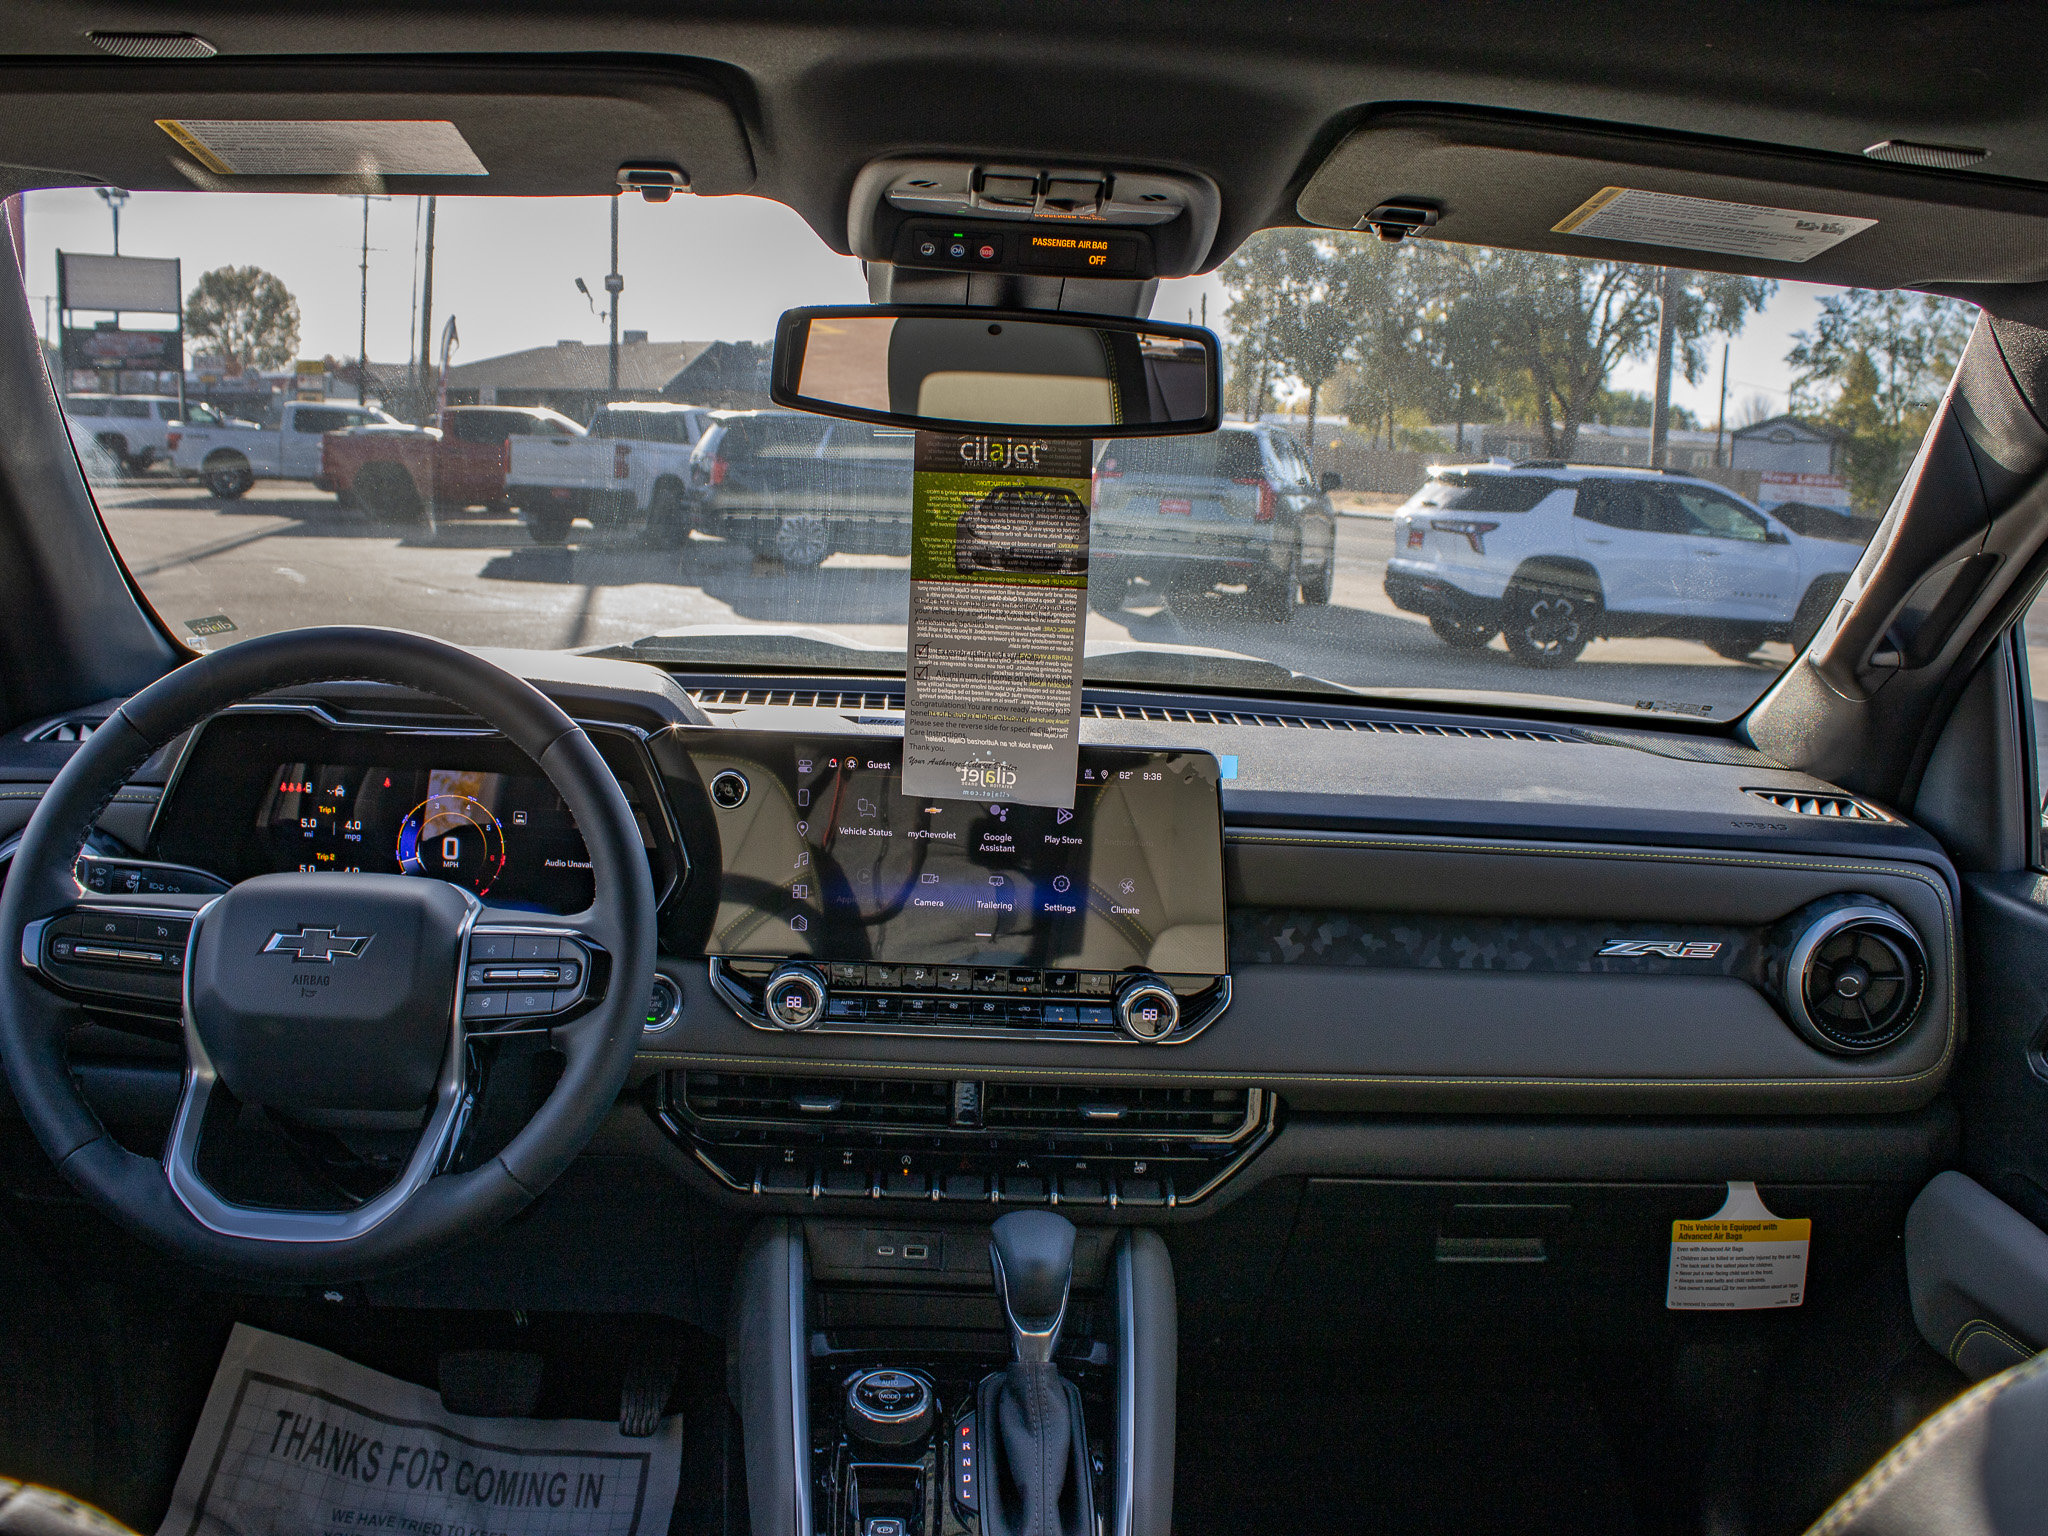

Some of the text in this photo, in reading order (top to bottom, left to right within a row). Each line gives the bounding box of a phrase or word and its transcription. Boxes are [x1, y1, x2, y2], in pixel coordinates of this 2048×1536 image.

[1032, 237, 1108, 250] PASSENGER AIR BAG
[1088, 255, 1107, 265] OFF
[910, 699, 967, 711] Congratulations!
[968, 702, 980, 711] You
[909, 719, 931, 728] Please
[909, 742, 928, 752] Thank
[867, 760, 891, 770] Guest
[1143, 772, 1162, 781] 9:36
[318, 805, 332, 815] Trip
[300, 818, 317, 829] 5.0
[344, 820, 362, 830] 4.0
[486, 824, 491, 832] 5
[303, 830, 314, 838] mi
[839, 826, 893, 837] Vehicle Status
[907, 830, 957, 840] myChevrolet
[344, 833, 362, 842] mpg
[983, 832, 1013, 844] Google
[1044, 835, 1083, 846] Play Store
[442, 837, 459, 860] 0
[979, 843, 1016, 853] Assistant
[316, 852, 336, 862] Trip 2
[544, 859, 594, 869] Audio Unavai
[914, 898, 944, 908] Camera
[976, 900, 1013, 912] Trailering
[1044, 903, 1076, 913] Settings
[1110, 906, 1140, 915] Climate
[1597, 939, 1722, 958] ZR2
[292, 974, 330, 986] AIRBAG
[786, 995, 802, 1009] 68
[1142, 1009, 1158, 1021] 68
[1075, 1161, 1087, 1169] AUX
[1679, 1223, 1778, 1232] This Vehicle is Equipped with
[1678, 1232, 1743, 1241] Advanced Air Bags
[961, 1427, 970, 1437] P
[962, 1442, 971, 1451] R
[270, 1409, 605, 1509] THANKS FOR COMING IN
[962, 1458, 971, 1467] N
[963, 1474, 971, 1483] D
[963, 1490, 971, 1498] L
[331, 1507, 355, 1524] WE
[356, 1510, 396, 1528] HAVE
[400, 1517, 443, 1534] TRIED
